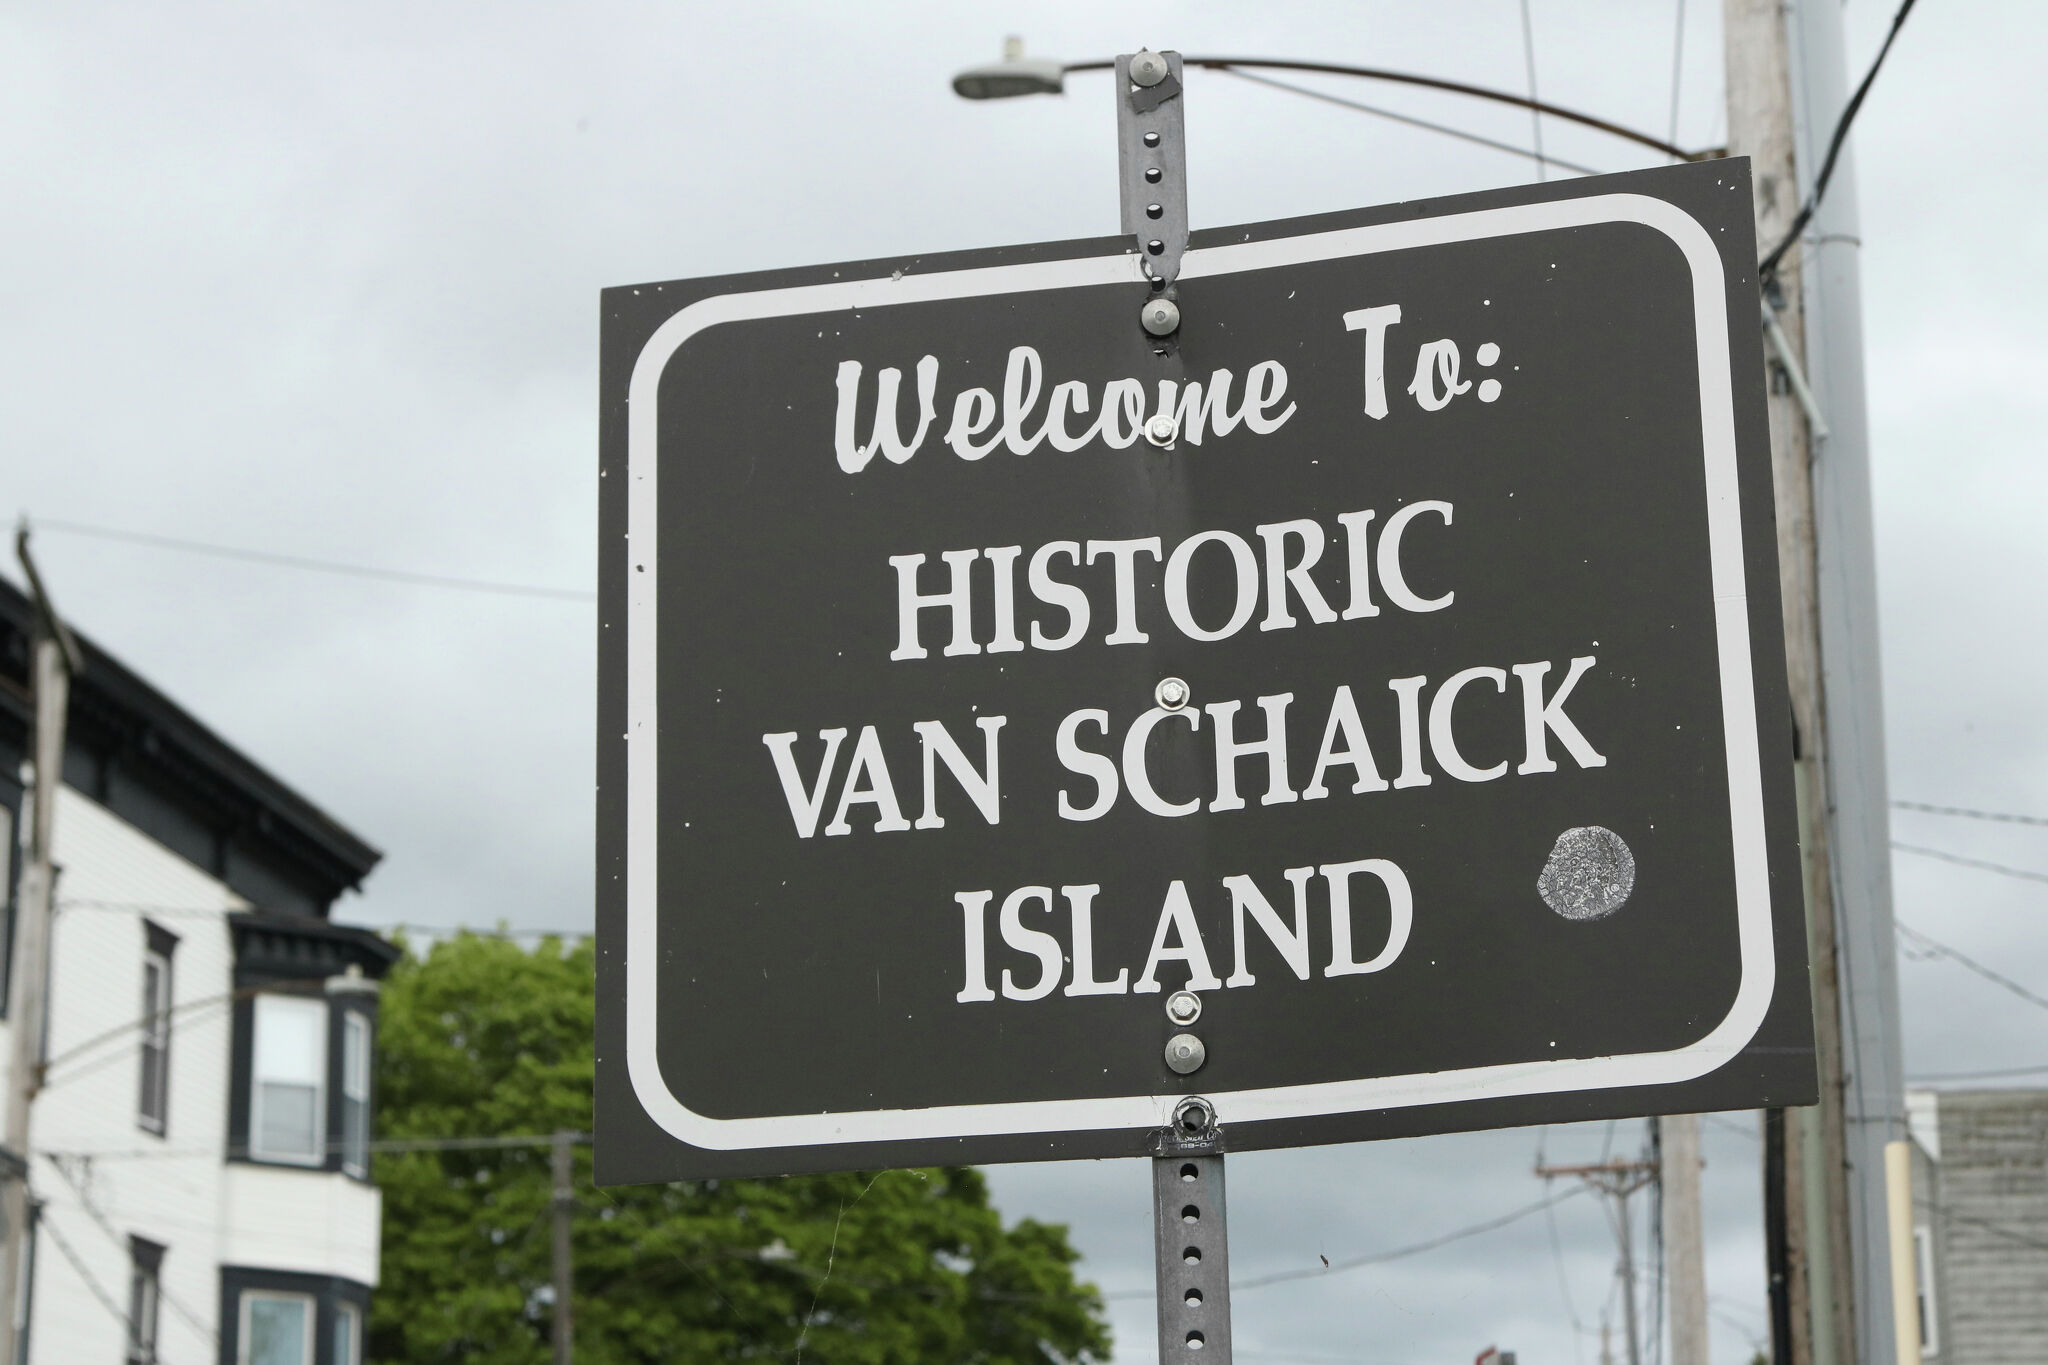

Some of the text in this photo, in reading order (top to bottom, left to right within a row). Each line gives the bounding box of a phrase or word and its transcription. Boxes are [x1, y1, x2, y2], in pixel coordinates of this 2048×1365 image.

[835, 299, 1502, 474] Welcome To:
[889, 500, 1455, 661] HISTORIC
[763, 655, 1607, 838] VAN SCHAICK
[955, 859, 1413, 1003] ISLAND
